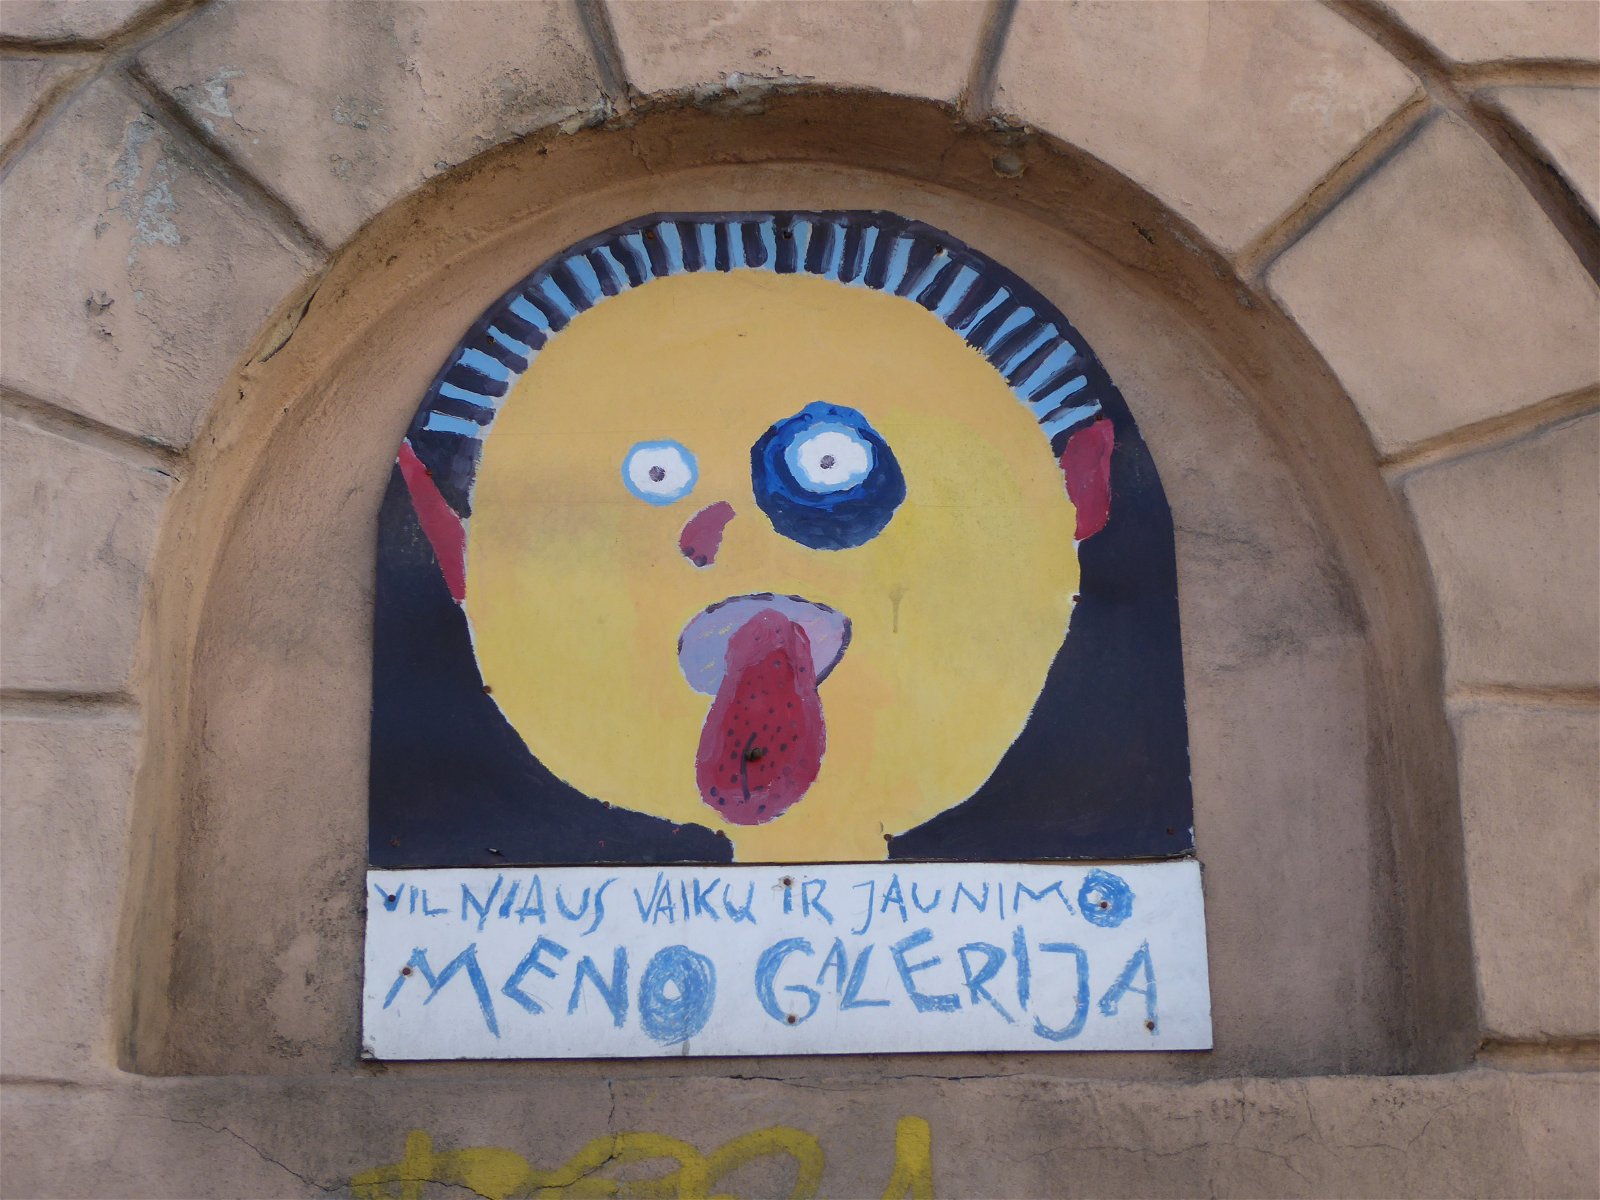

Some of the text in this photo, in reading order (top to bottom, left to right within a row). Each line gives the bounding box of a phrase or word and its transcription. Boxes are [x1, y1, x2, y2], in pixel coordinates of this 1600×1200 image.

[374, 873, 619, 936] VILNIAUS
[783, 877, 834, 925] IR
[850, 868, 1136, 936] JAUNIMO
[382, 925, 1160, 1046] MENO GALERIJA
